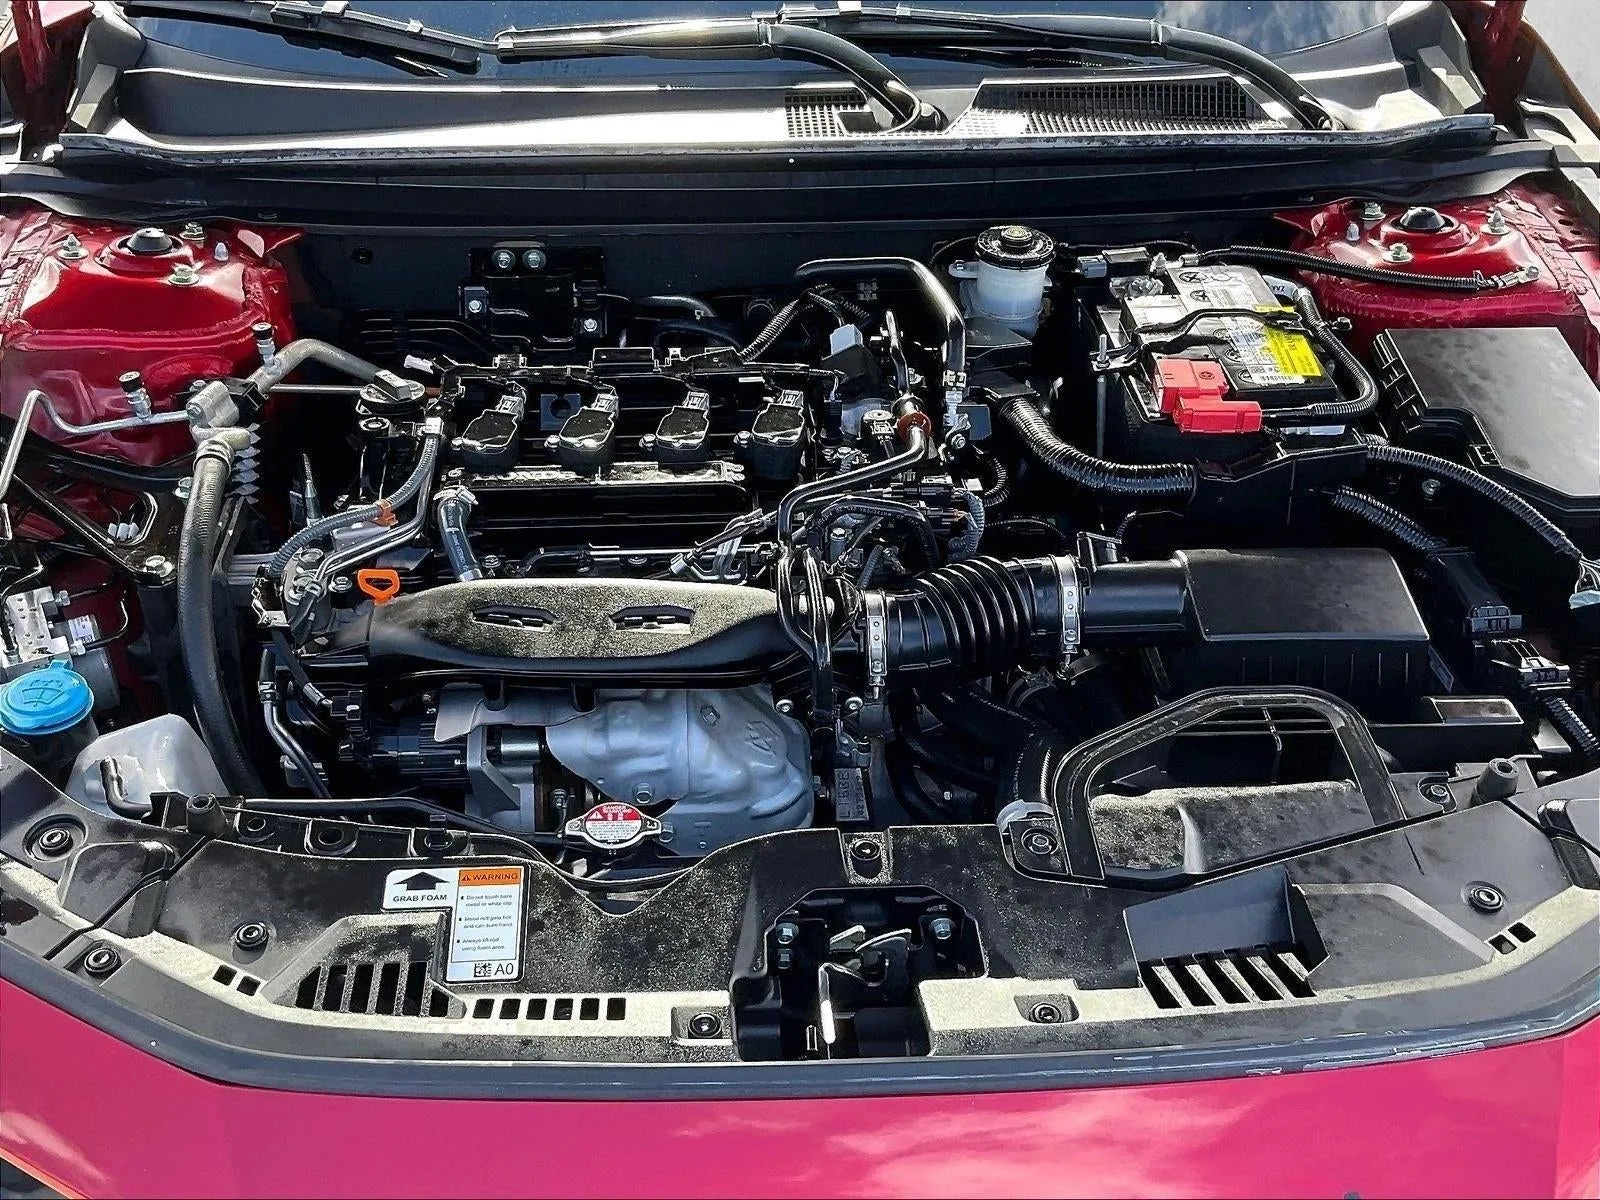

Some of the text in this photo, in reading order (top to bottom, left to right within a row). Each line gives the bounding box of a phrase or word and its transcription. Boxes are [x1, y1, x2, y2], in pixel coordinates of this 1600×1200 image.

[472, 872, 519, 881] WARNING
[392, 894, 447, 903] GRAB FOAM
